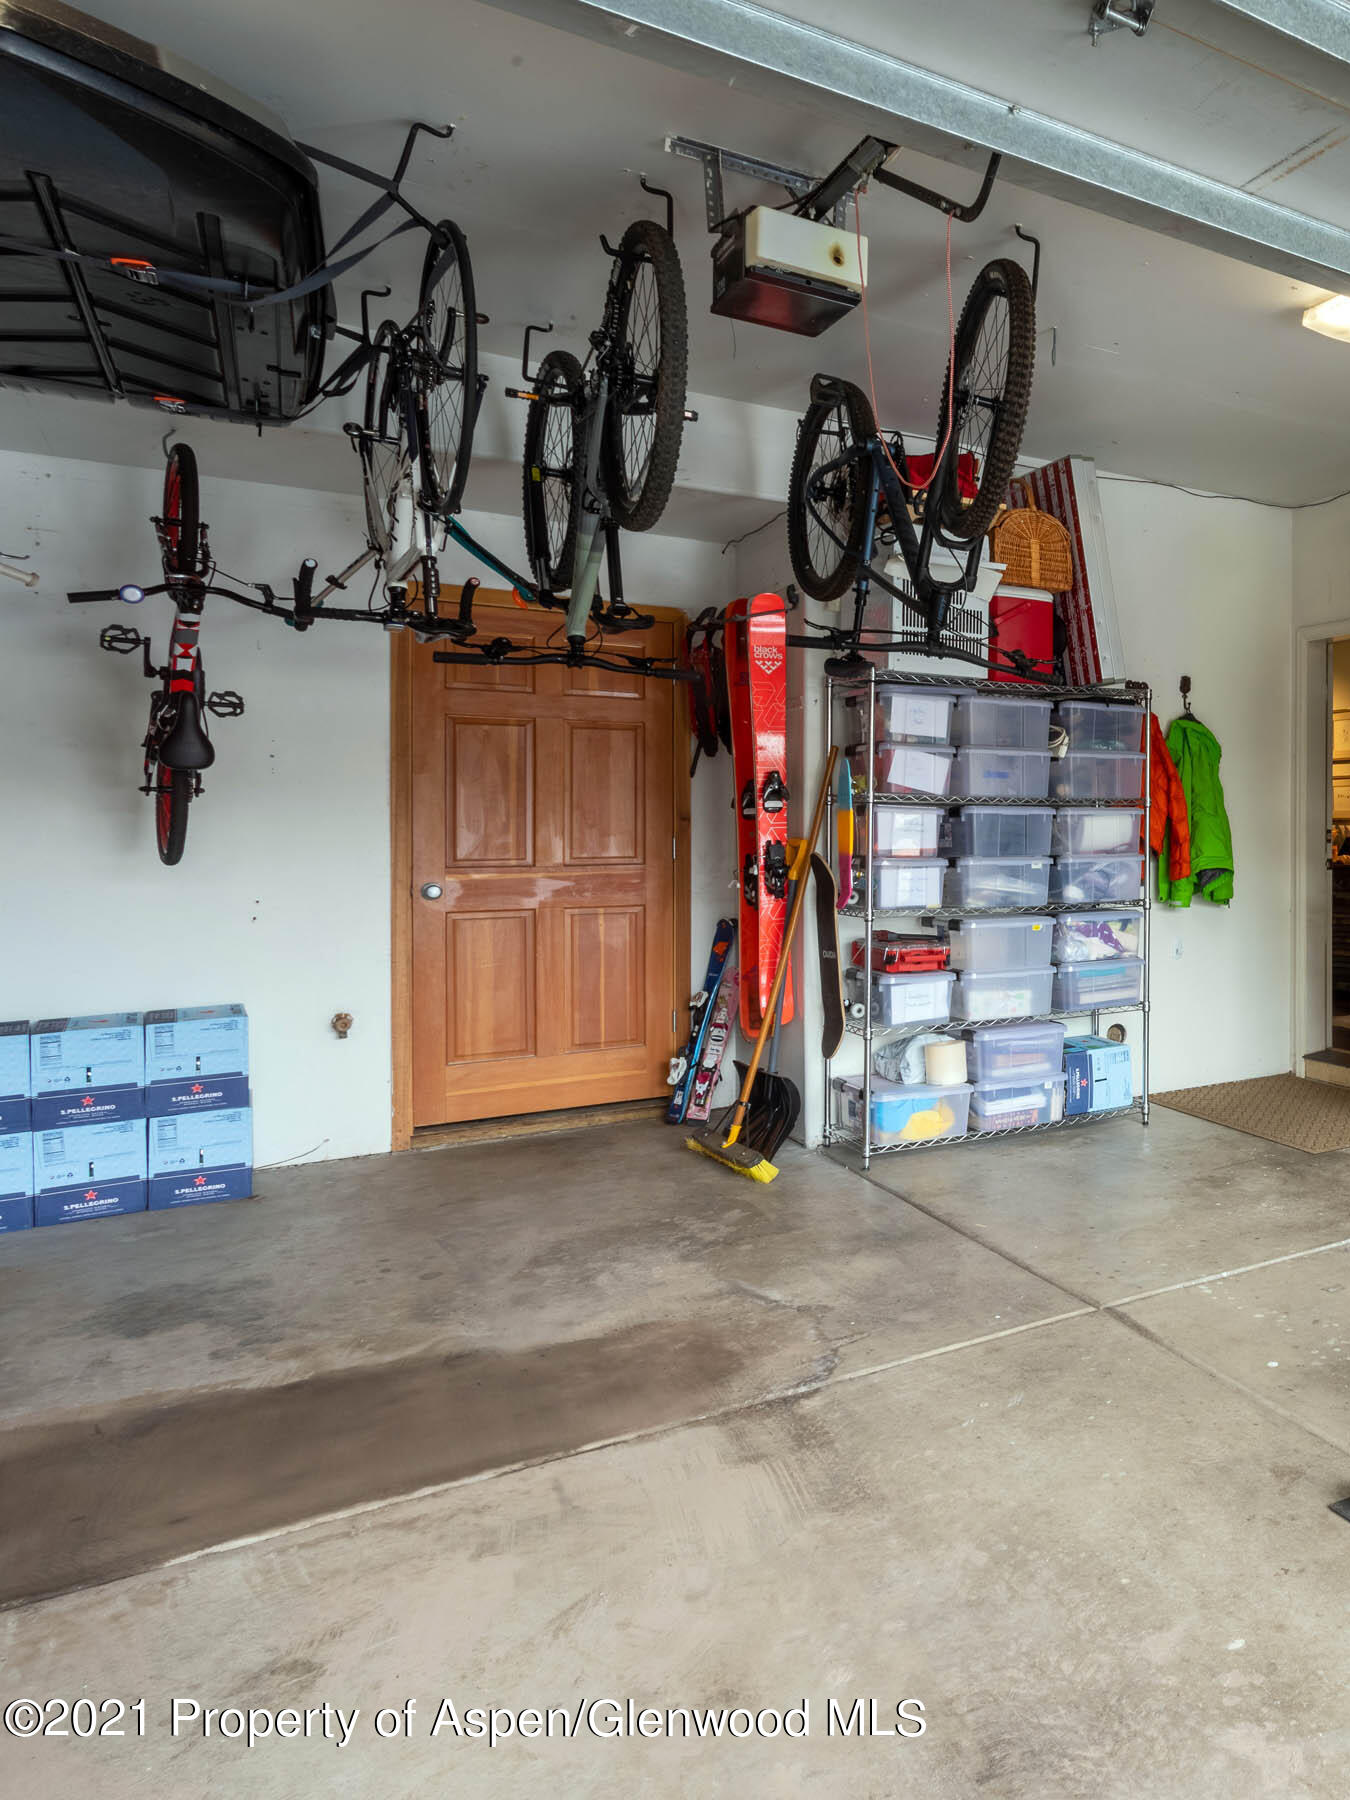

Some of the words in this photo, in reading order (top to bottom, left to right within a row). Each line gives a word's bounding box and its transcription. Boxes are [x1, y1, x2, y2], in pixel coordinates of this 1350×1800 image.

[754, 645, 777, 653] black
[754, 651, 783, 660] crows
[171, 1091, 223, 1103] S.PELLEGRINO
[60, 1104, 116, 1116] S.PELLEGRINO
[174, 1183, 226, 1195] S.PELLEGRINO
[63, 1197, 119, 1211] S.PELLEGRINO
